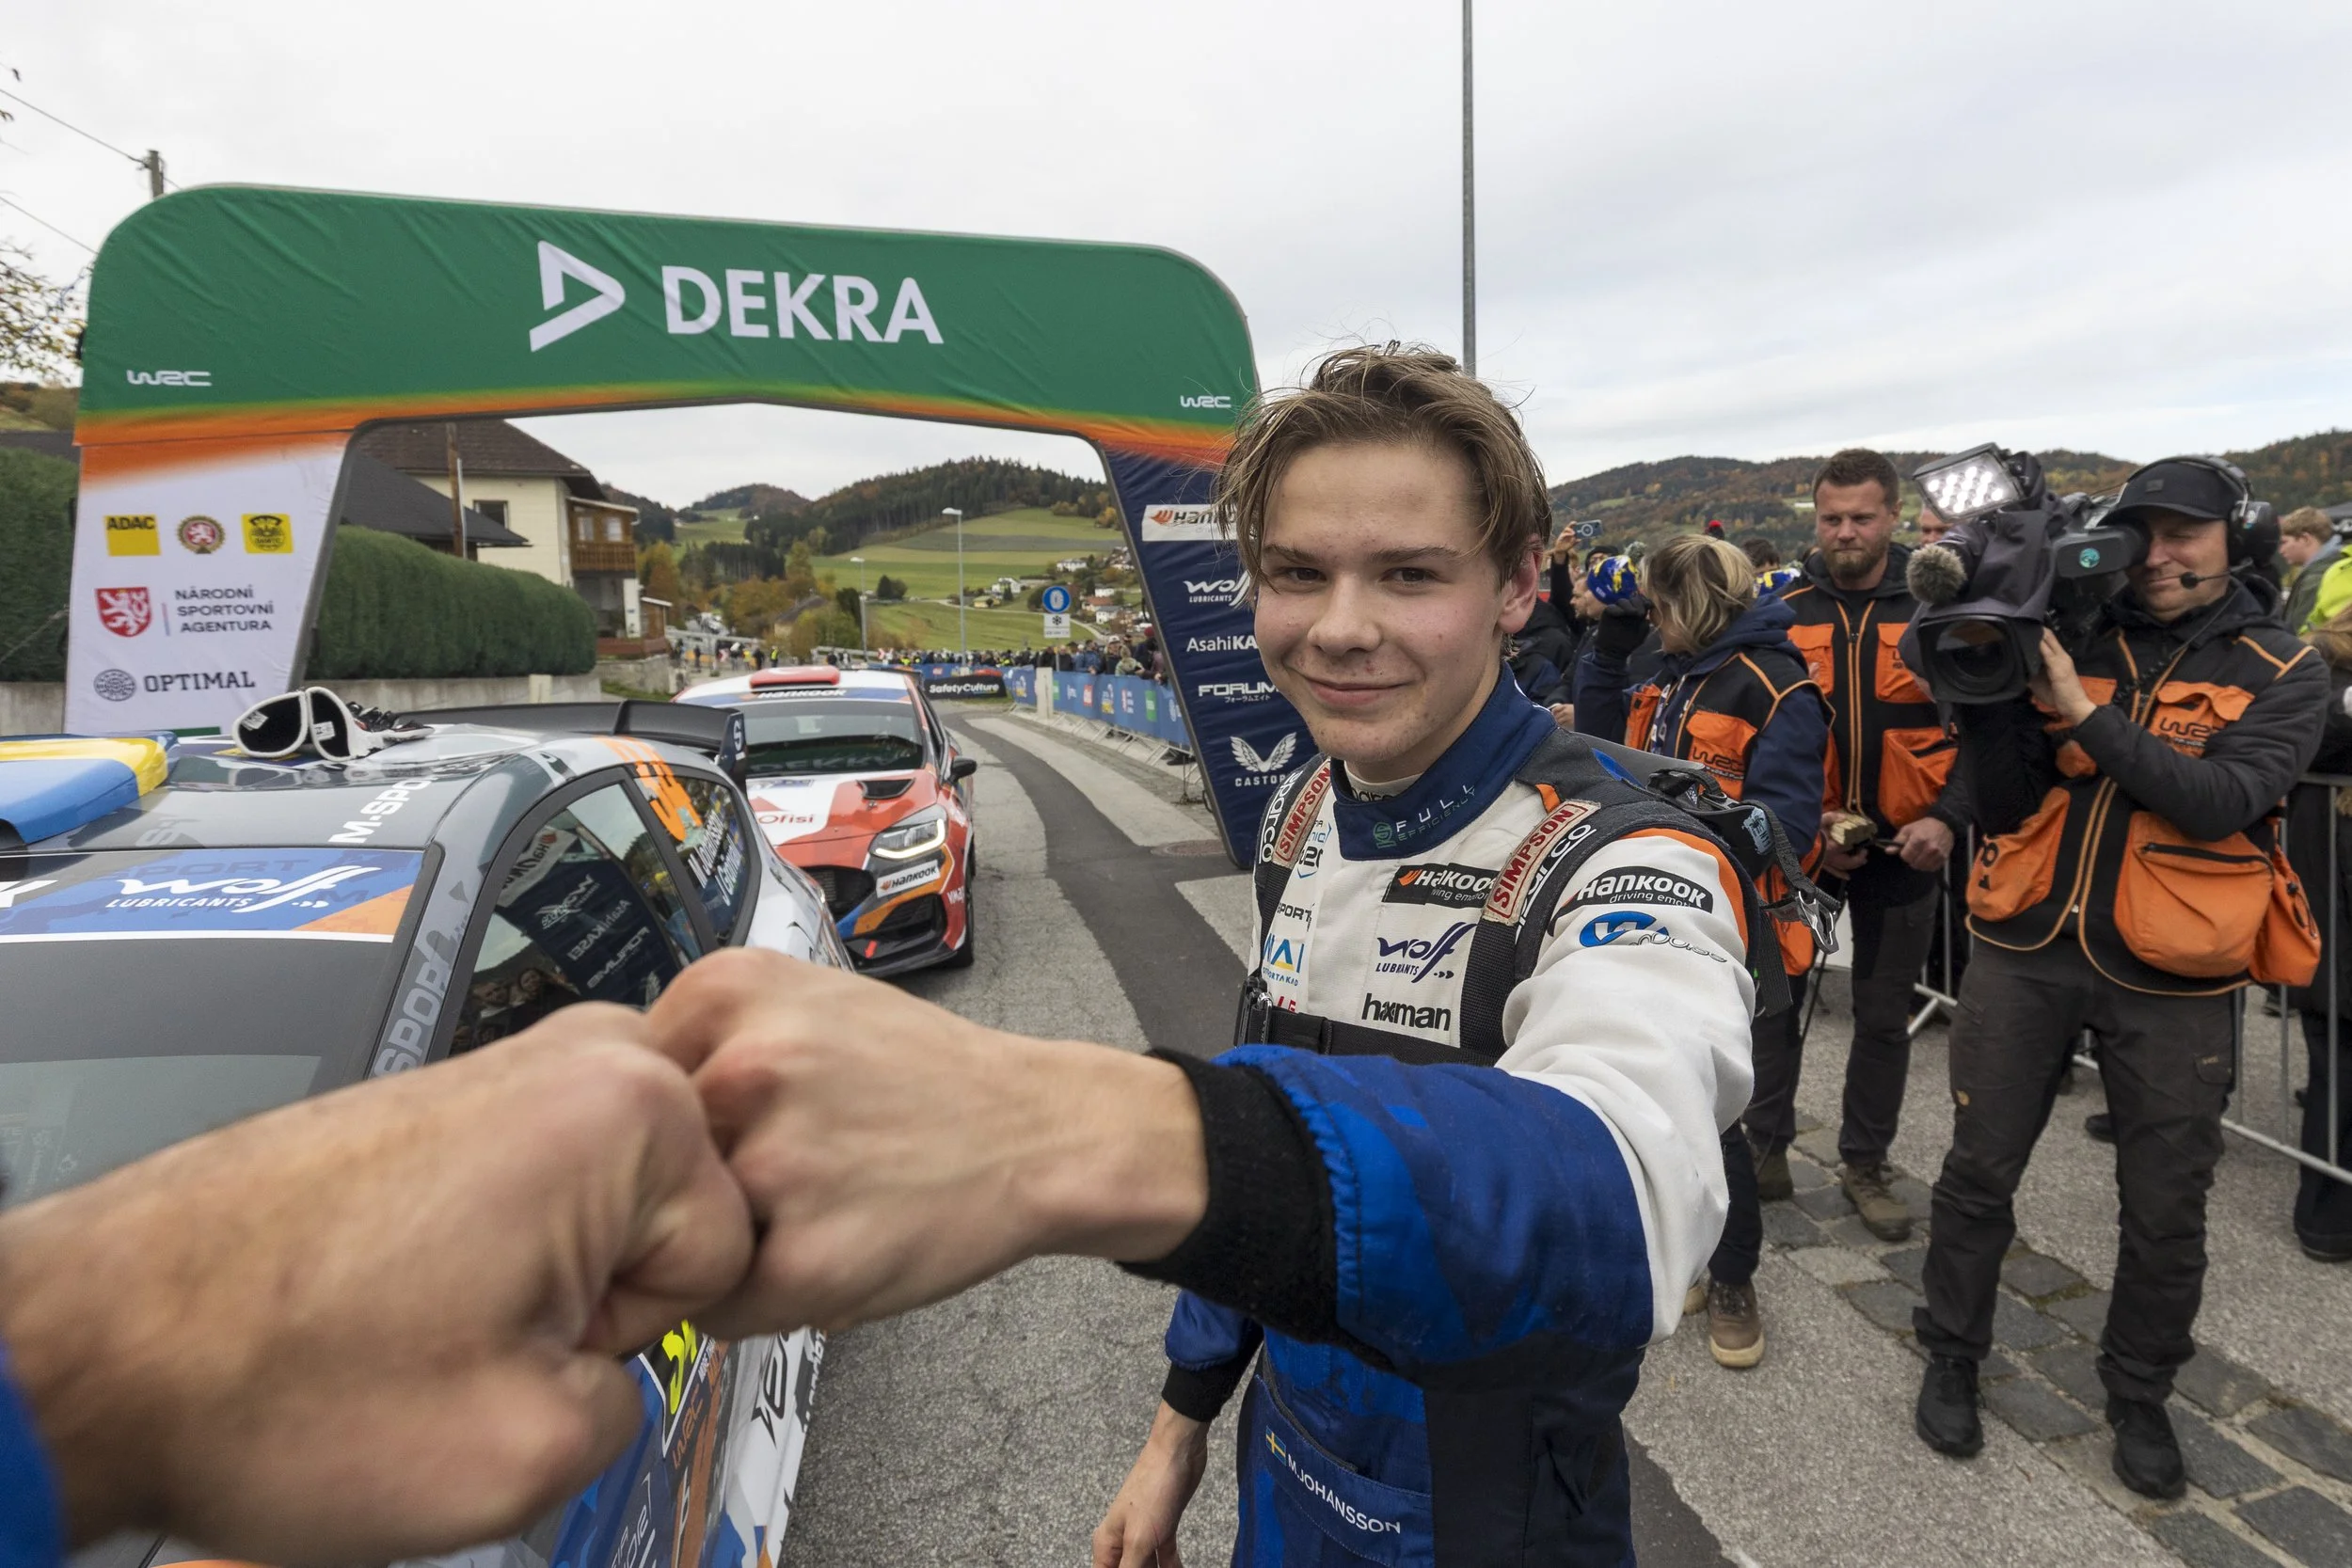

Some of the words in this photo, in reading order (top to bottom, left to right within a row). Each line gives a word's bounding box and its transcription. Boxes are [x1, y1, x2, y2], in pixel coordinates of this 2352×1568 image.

[661, 265, 945, 344] DEKRA
[126, 370, 213, 387] WRC
[1180, 394, 1232, 408] WRC
[107, 517, 156, 531] ADAC
[175, 584, 254, 600] NÁRODNÍ
[1189, 594, 1232, 603] LUBRICANTS
[177, 601, 275, 616] SPORTOVNÍ
[180, 621, 272, 633] AGENTURA
[144, 671, 256, 692] OPTIMAL
[930, 683, 1000, 694] SafetyCulture
[1279, 767, 1331, 855] SIMPSON
[758, 814, 814, 824] Ofisi
[1493, 808, 1575, 910] SIMPSON
[105, 896, 254, 909] LUBRICANTS
[1609, 891, 1654, 904] driving
[1288, 1453, 1401, 1535] M.JOHANSSON
